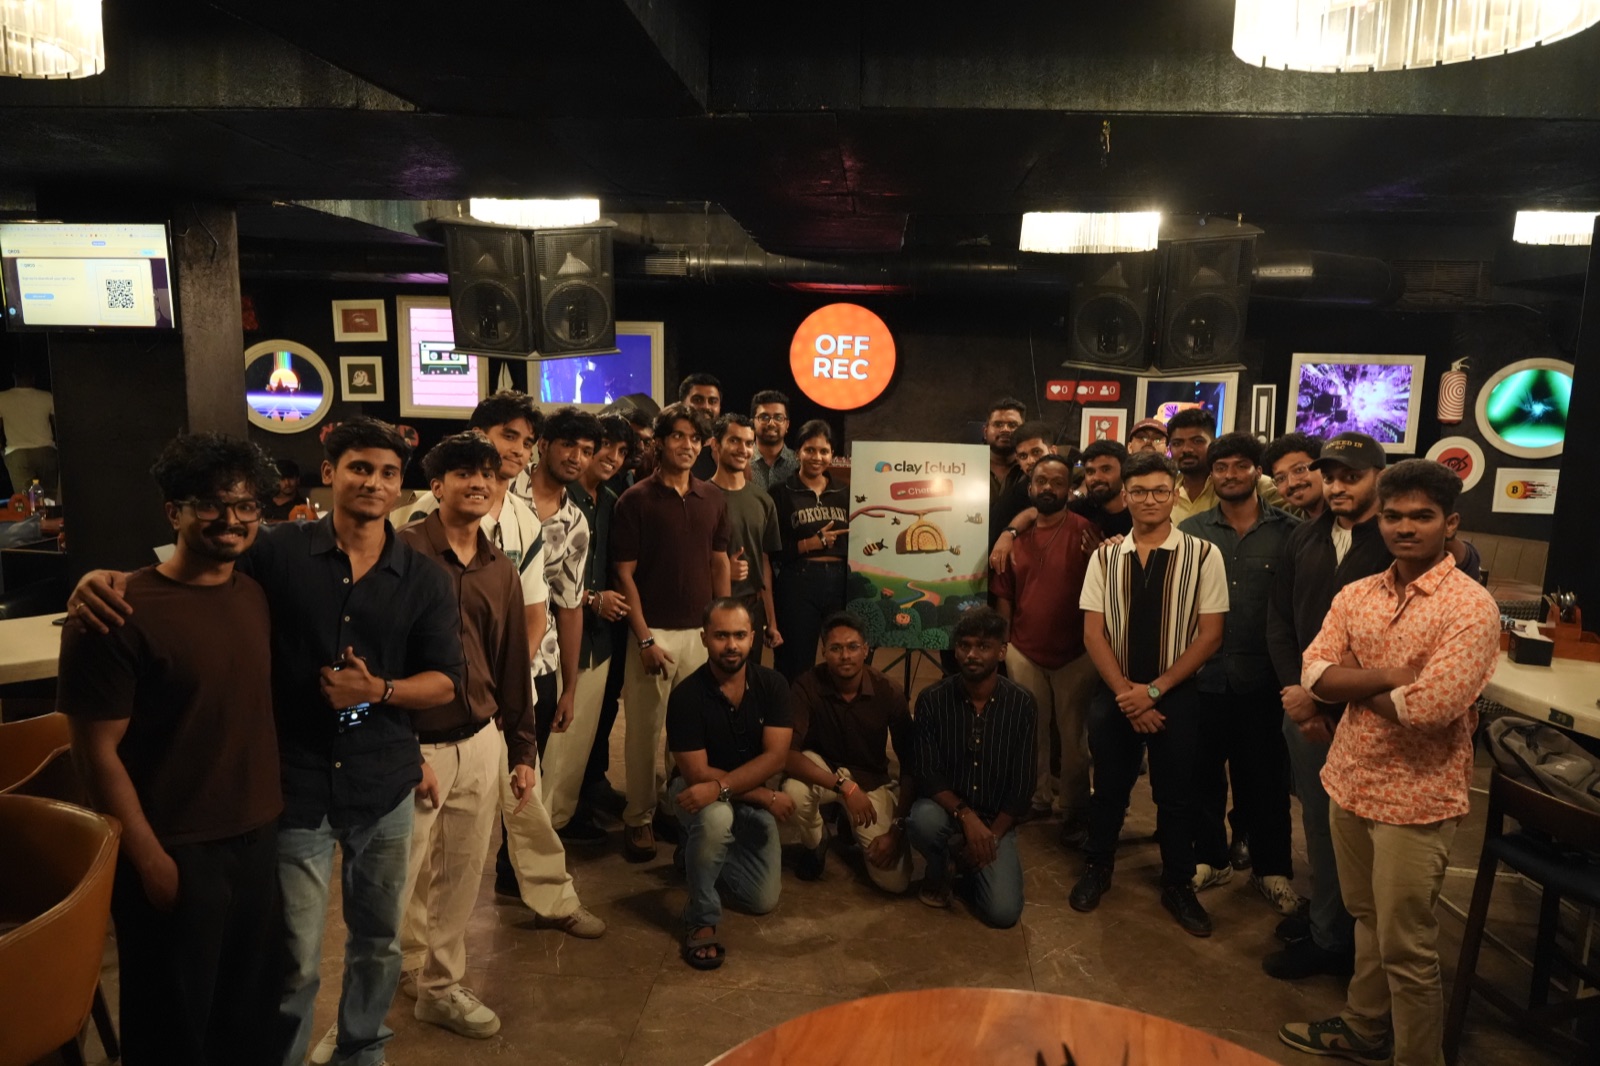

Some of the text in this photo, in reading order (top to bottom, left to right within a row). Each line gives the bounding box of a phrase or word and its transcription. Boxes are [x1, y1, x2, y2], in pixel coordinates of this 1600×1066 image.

[815, 334, 870, 356] OFF
[813, 357, 869, 380] REC
[894, 460, 966, 476] clay [club]
